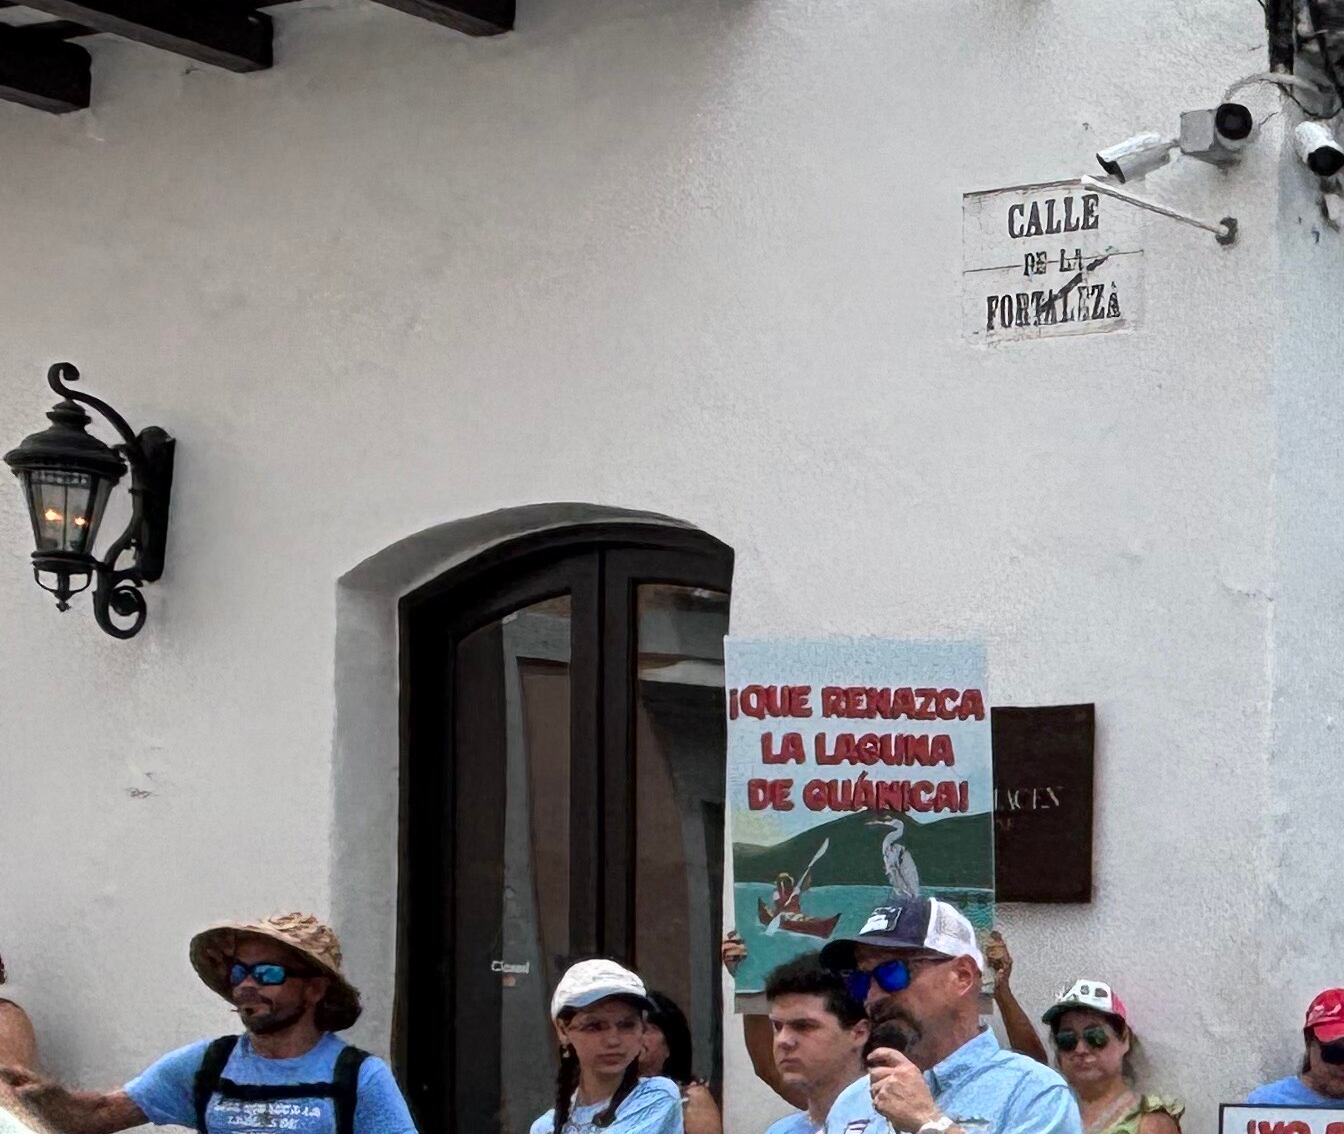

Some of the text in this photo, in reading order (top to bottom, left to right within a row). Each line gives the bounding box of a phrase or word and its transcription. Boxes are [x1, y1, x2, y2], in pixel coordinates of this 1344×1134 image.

[1008, 194, 1099, 239] CALLE
[1023, 248, 1083, 276] DE LA
[986, 281, 1121, 331] FORTALEZA
[821, 686, 985, 721] RENAZCA
[761, 732, 955, 766] LA LAGUNA
[747, 770, 969, 813] DE GUÁNICA!
